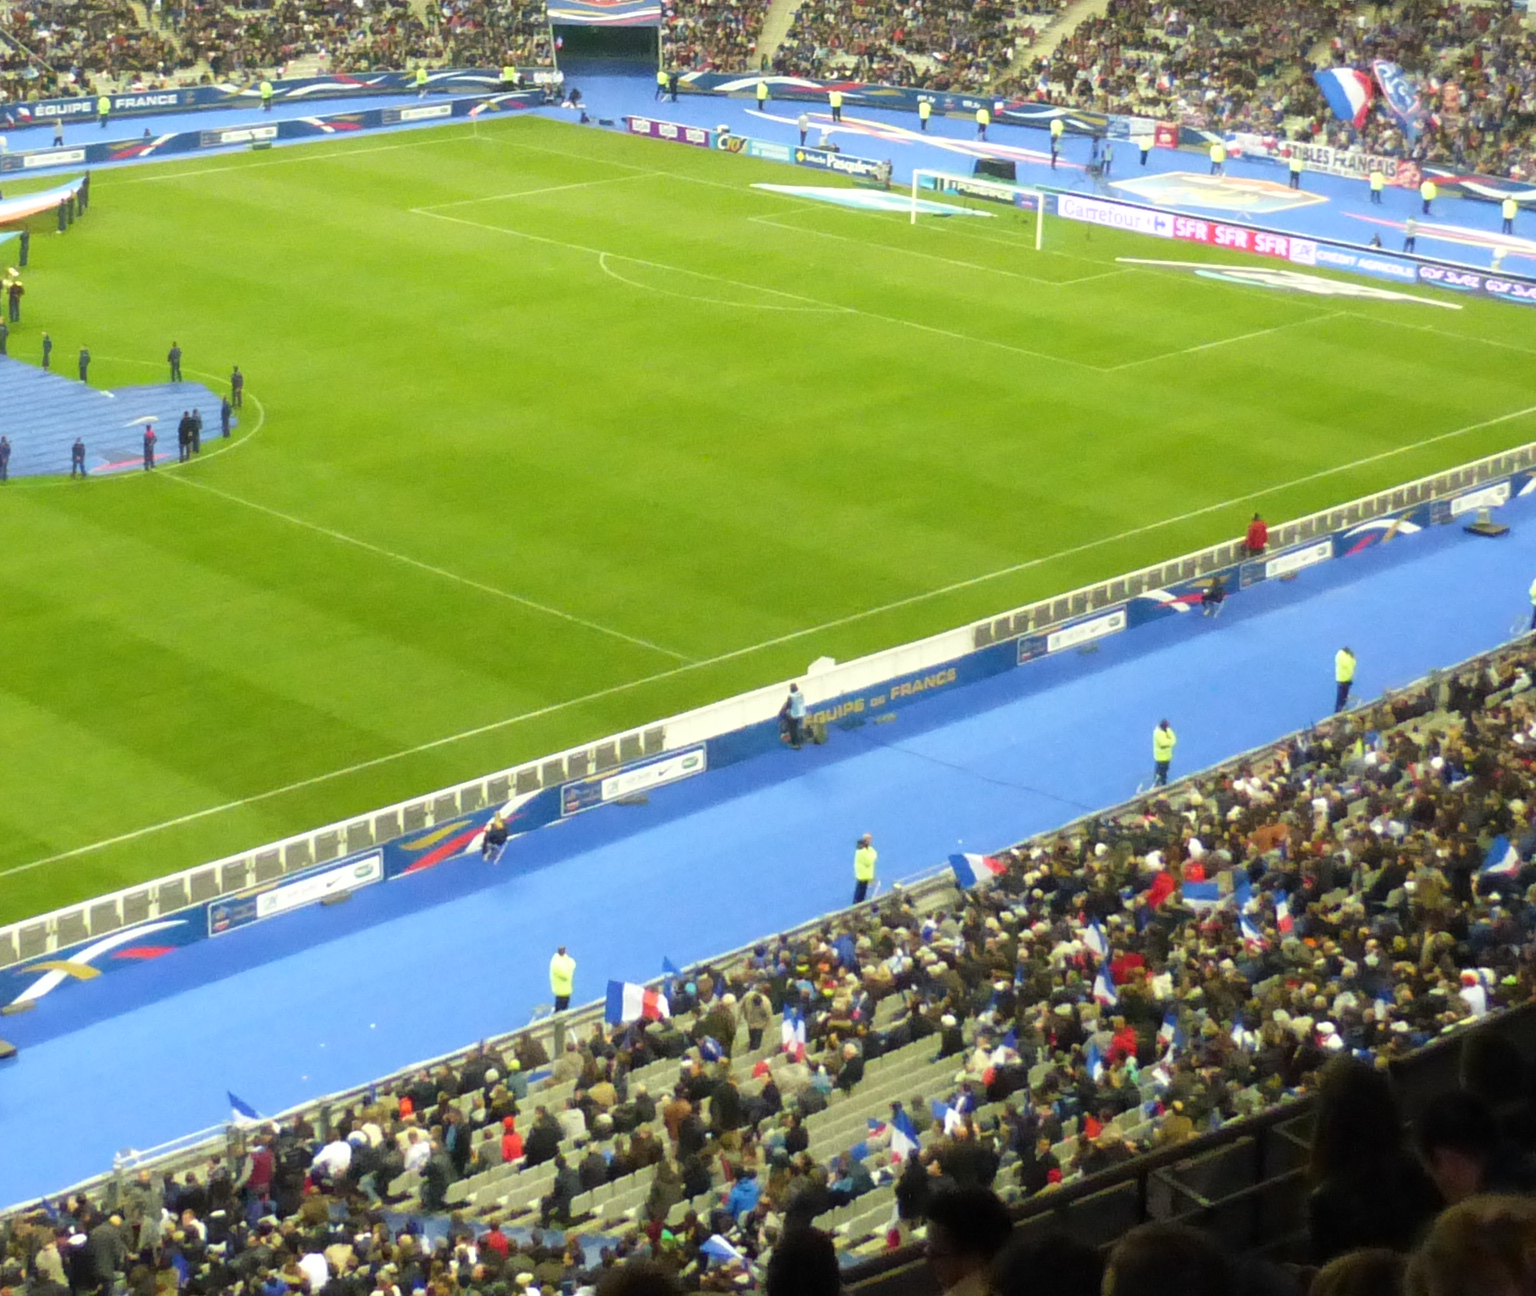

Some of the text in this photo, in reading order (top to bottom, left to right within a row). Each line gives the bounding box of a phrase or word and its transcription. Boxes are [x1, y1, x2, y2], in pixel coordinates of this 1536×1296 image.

[114, 94, 178, 109] FRANCE
[1064, 199, 1142, 228] Carrefour
[1175, 218, 1289, 257] SFR SFR SFR
[890, 668, 957, 700] FRANCE
